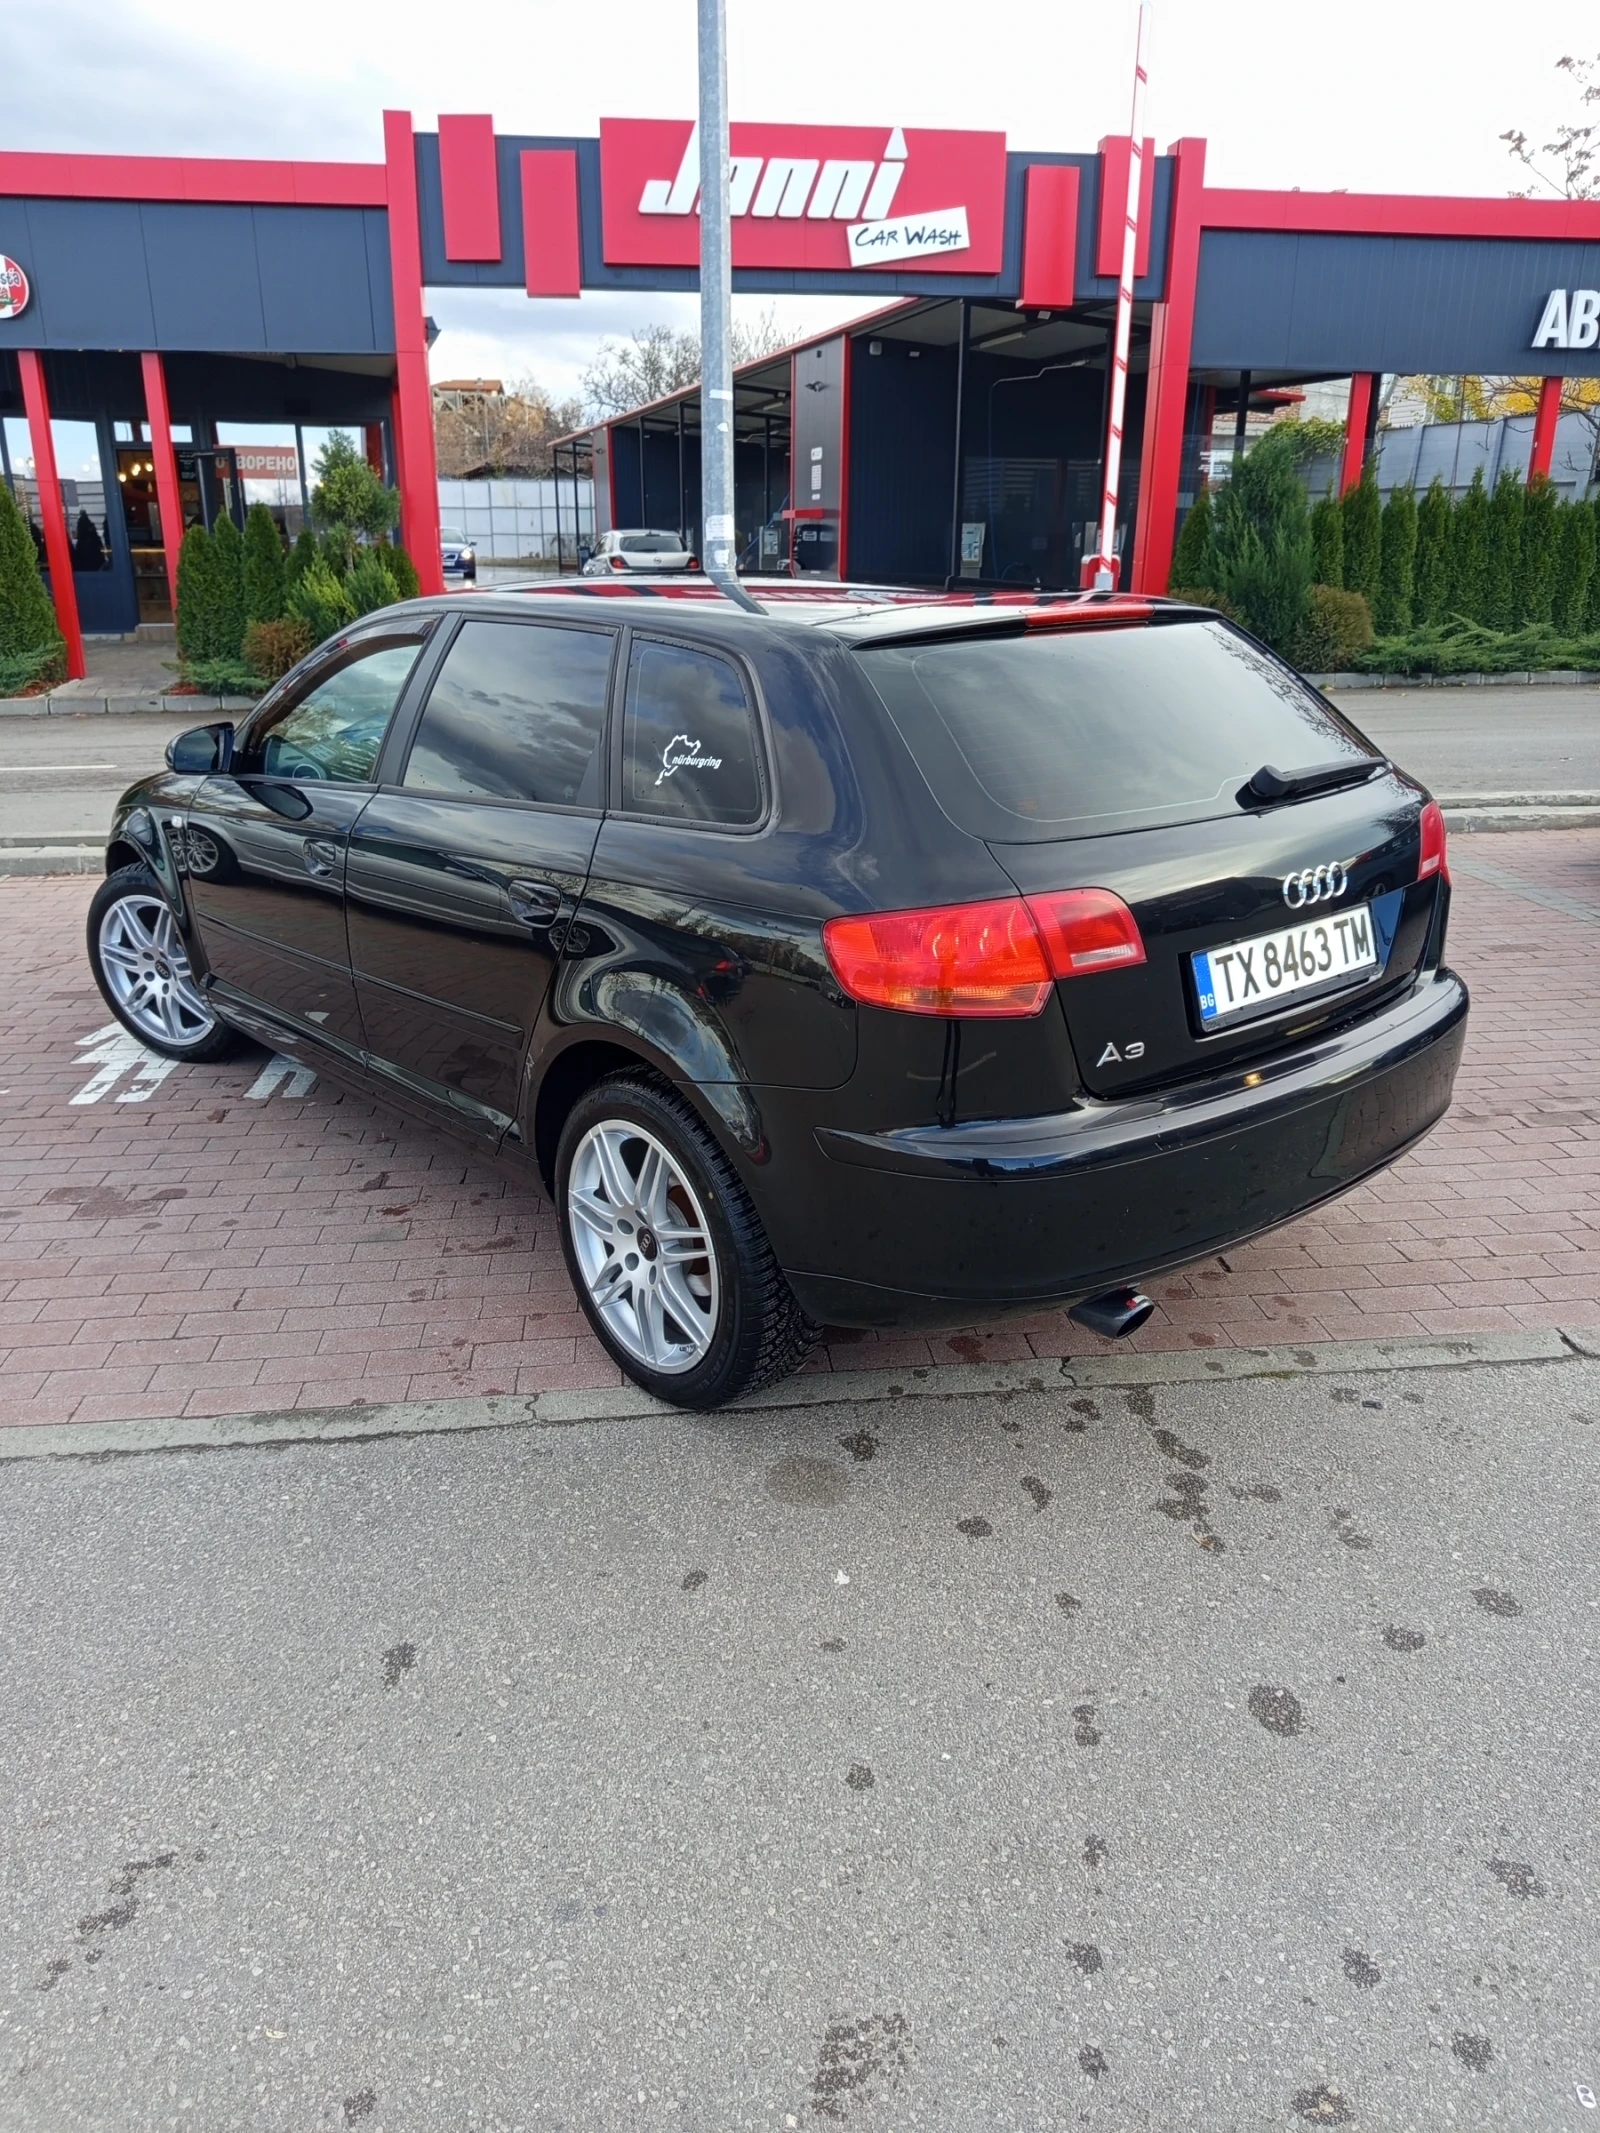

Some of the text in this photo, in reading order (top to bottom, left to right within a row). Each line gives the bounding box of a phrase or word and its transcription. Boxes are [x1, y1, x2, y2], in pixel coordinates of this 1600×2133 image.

[855, 226, 962, 247] CAR WASH
[1531, 289, 1600, 349] АВ
[672, 754, 722, 769] nürburgring
[1215, 914, 1371, 1002] TX 8463 TM
[1200, 993, 1215, 1010] BG
[1096, 1042, 1145, 1067] A3
